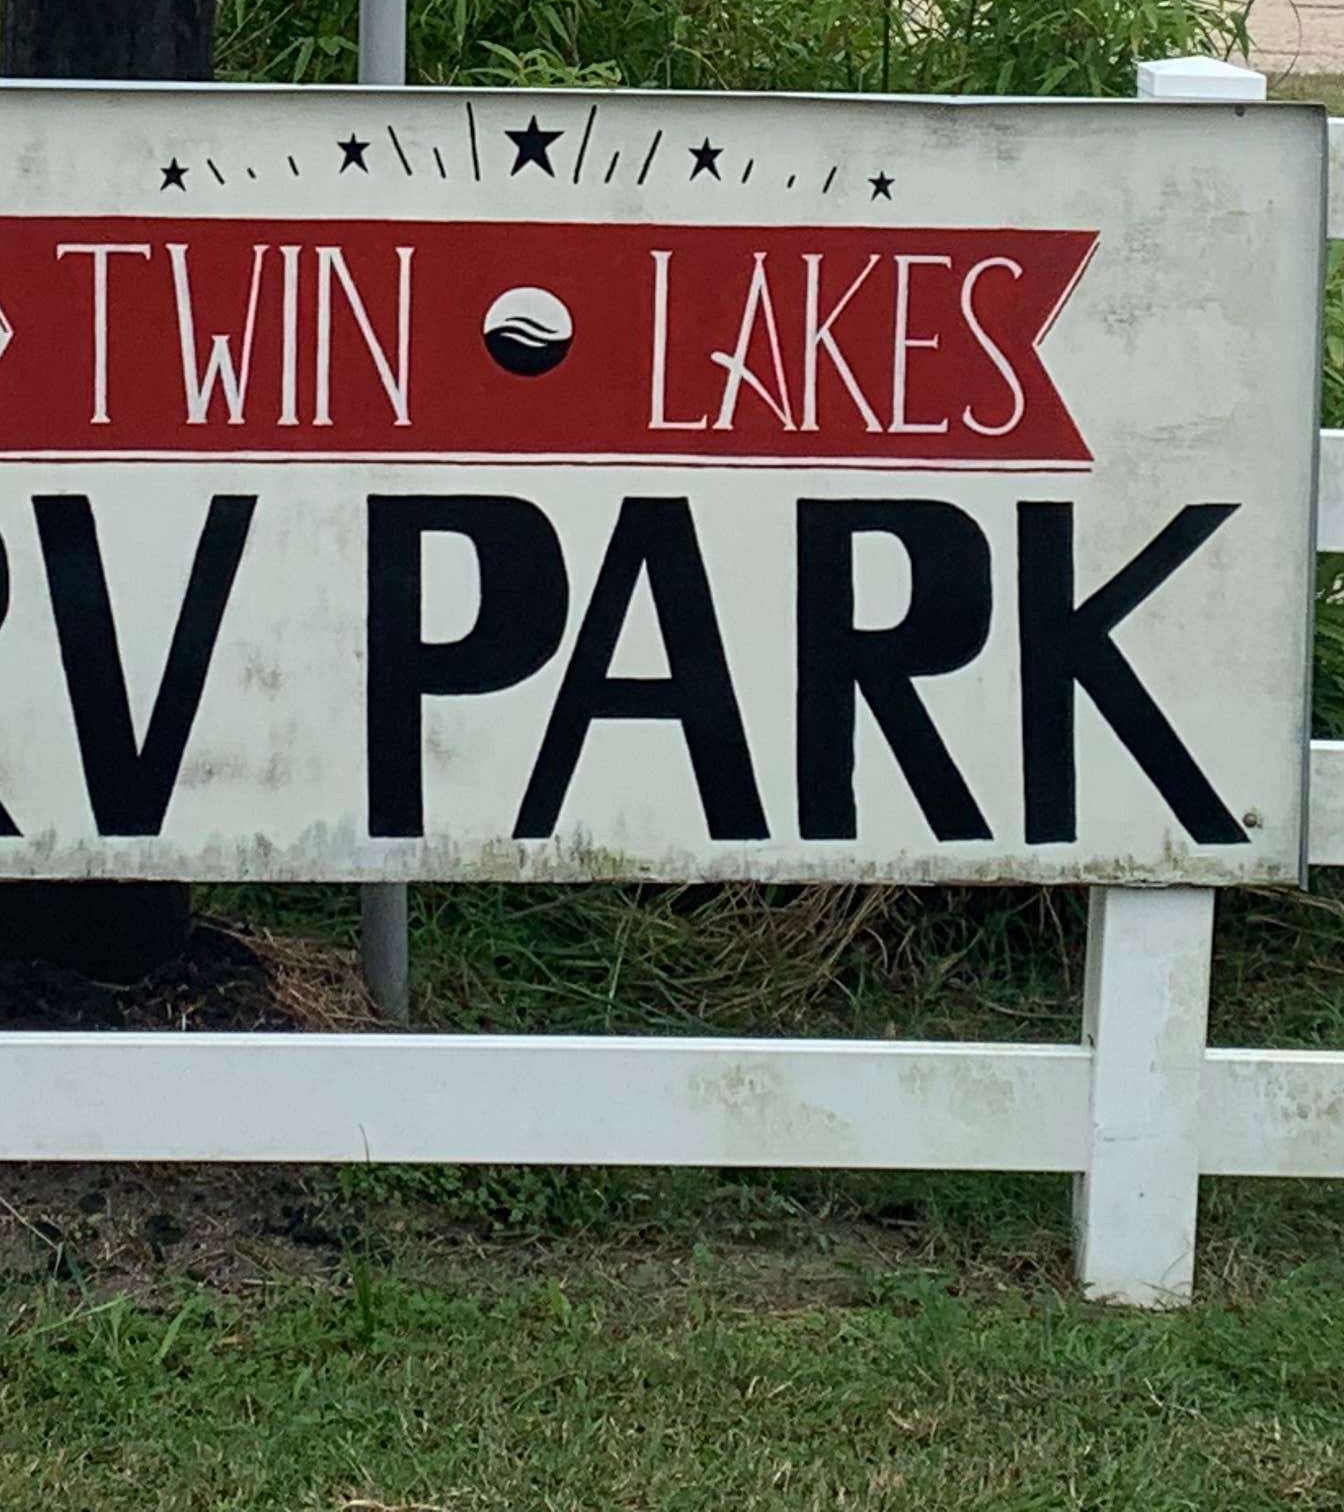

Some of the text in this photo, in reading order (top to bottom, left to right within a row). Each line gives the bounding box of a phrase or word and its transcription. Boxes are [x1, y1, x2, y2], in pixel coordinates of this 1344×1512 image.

[57, 243, 1025, 436] TWIN LAKES
[367, 494, 1251, 845] PARK
